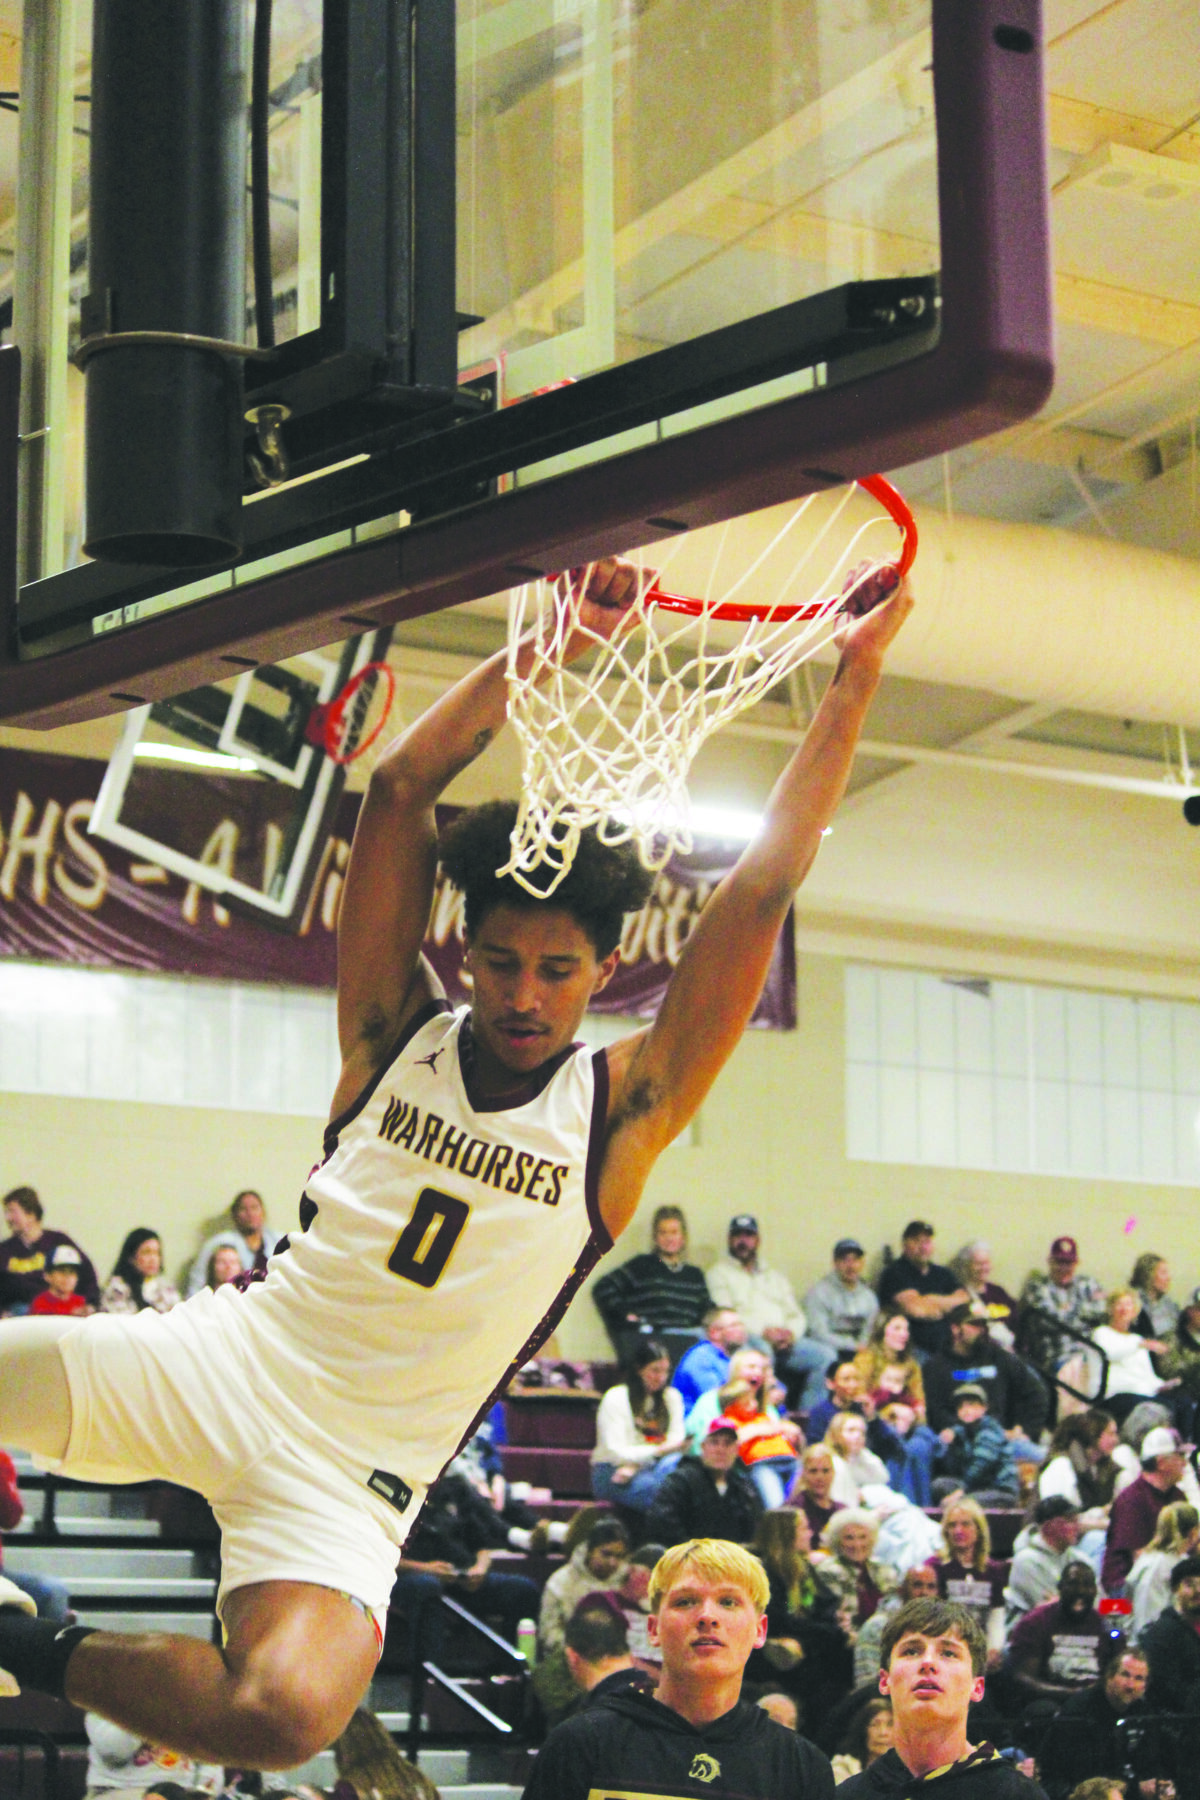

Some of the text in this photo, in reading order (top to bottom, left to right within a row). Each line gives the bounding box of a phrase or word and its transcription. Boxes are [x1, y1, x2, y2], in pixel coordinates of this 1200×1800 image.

[0, 790, 108, 910] HS
[378, 1095, 570, 1207] WARHORSES
[385, 1185, 472, 1291] 0
